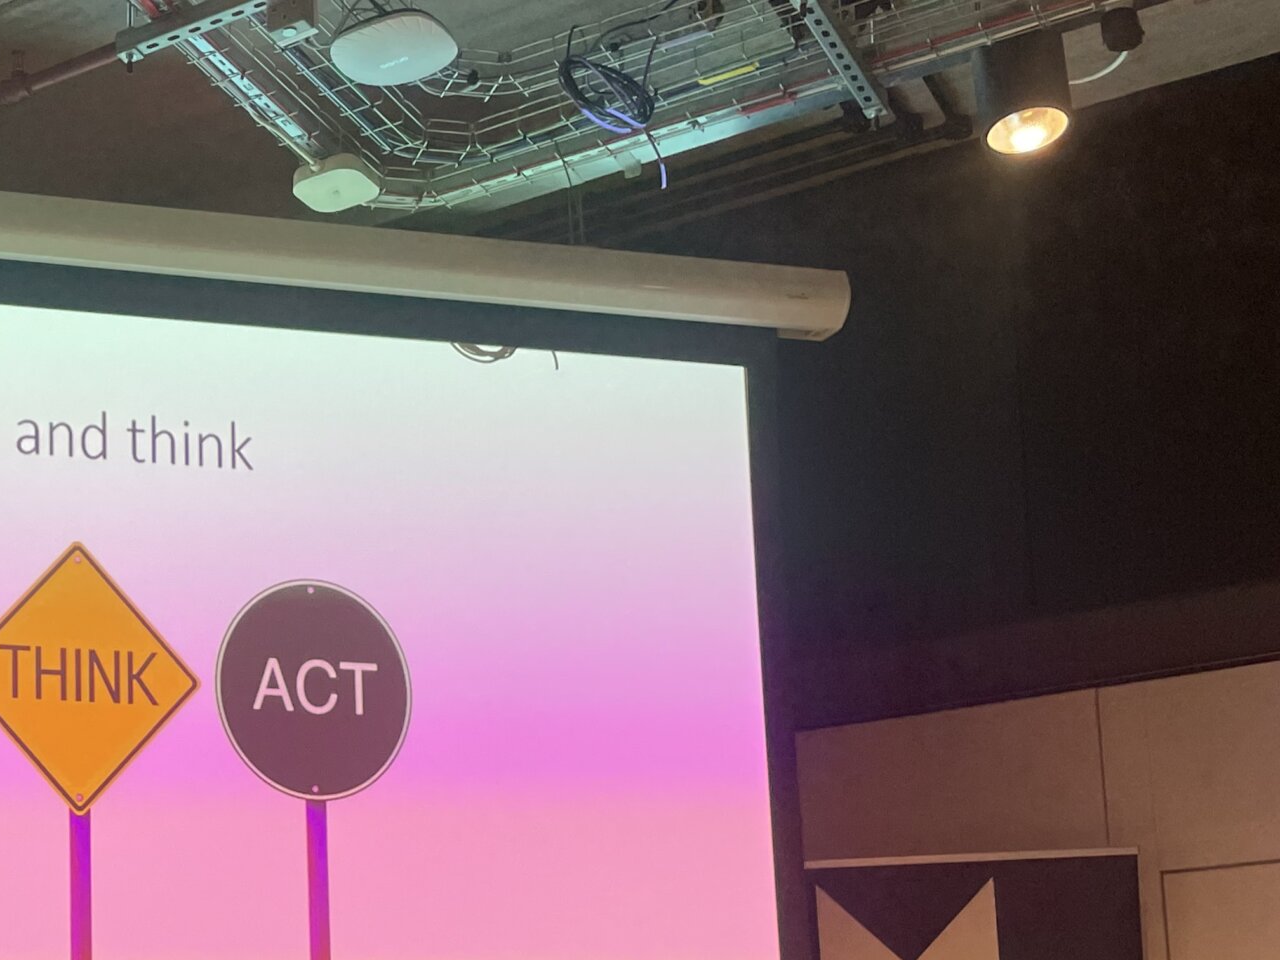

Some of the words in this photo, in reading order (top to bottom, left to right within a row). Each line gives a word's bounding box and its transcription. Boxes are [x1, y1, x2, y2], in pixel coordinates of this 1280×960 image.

[16, 411, 107, 459] and
[126, 415, 254, 470] think
[252, 657, 378, 716] ACT
